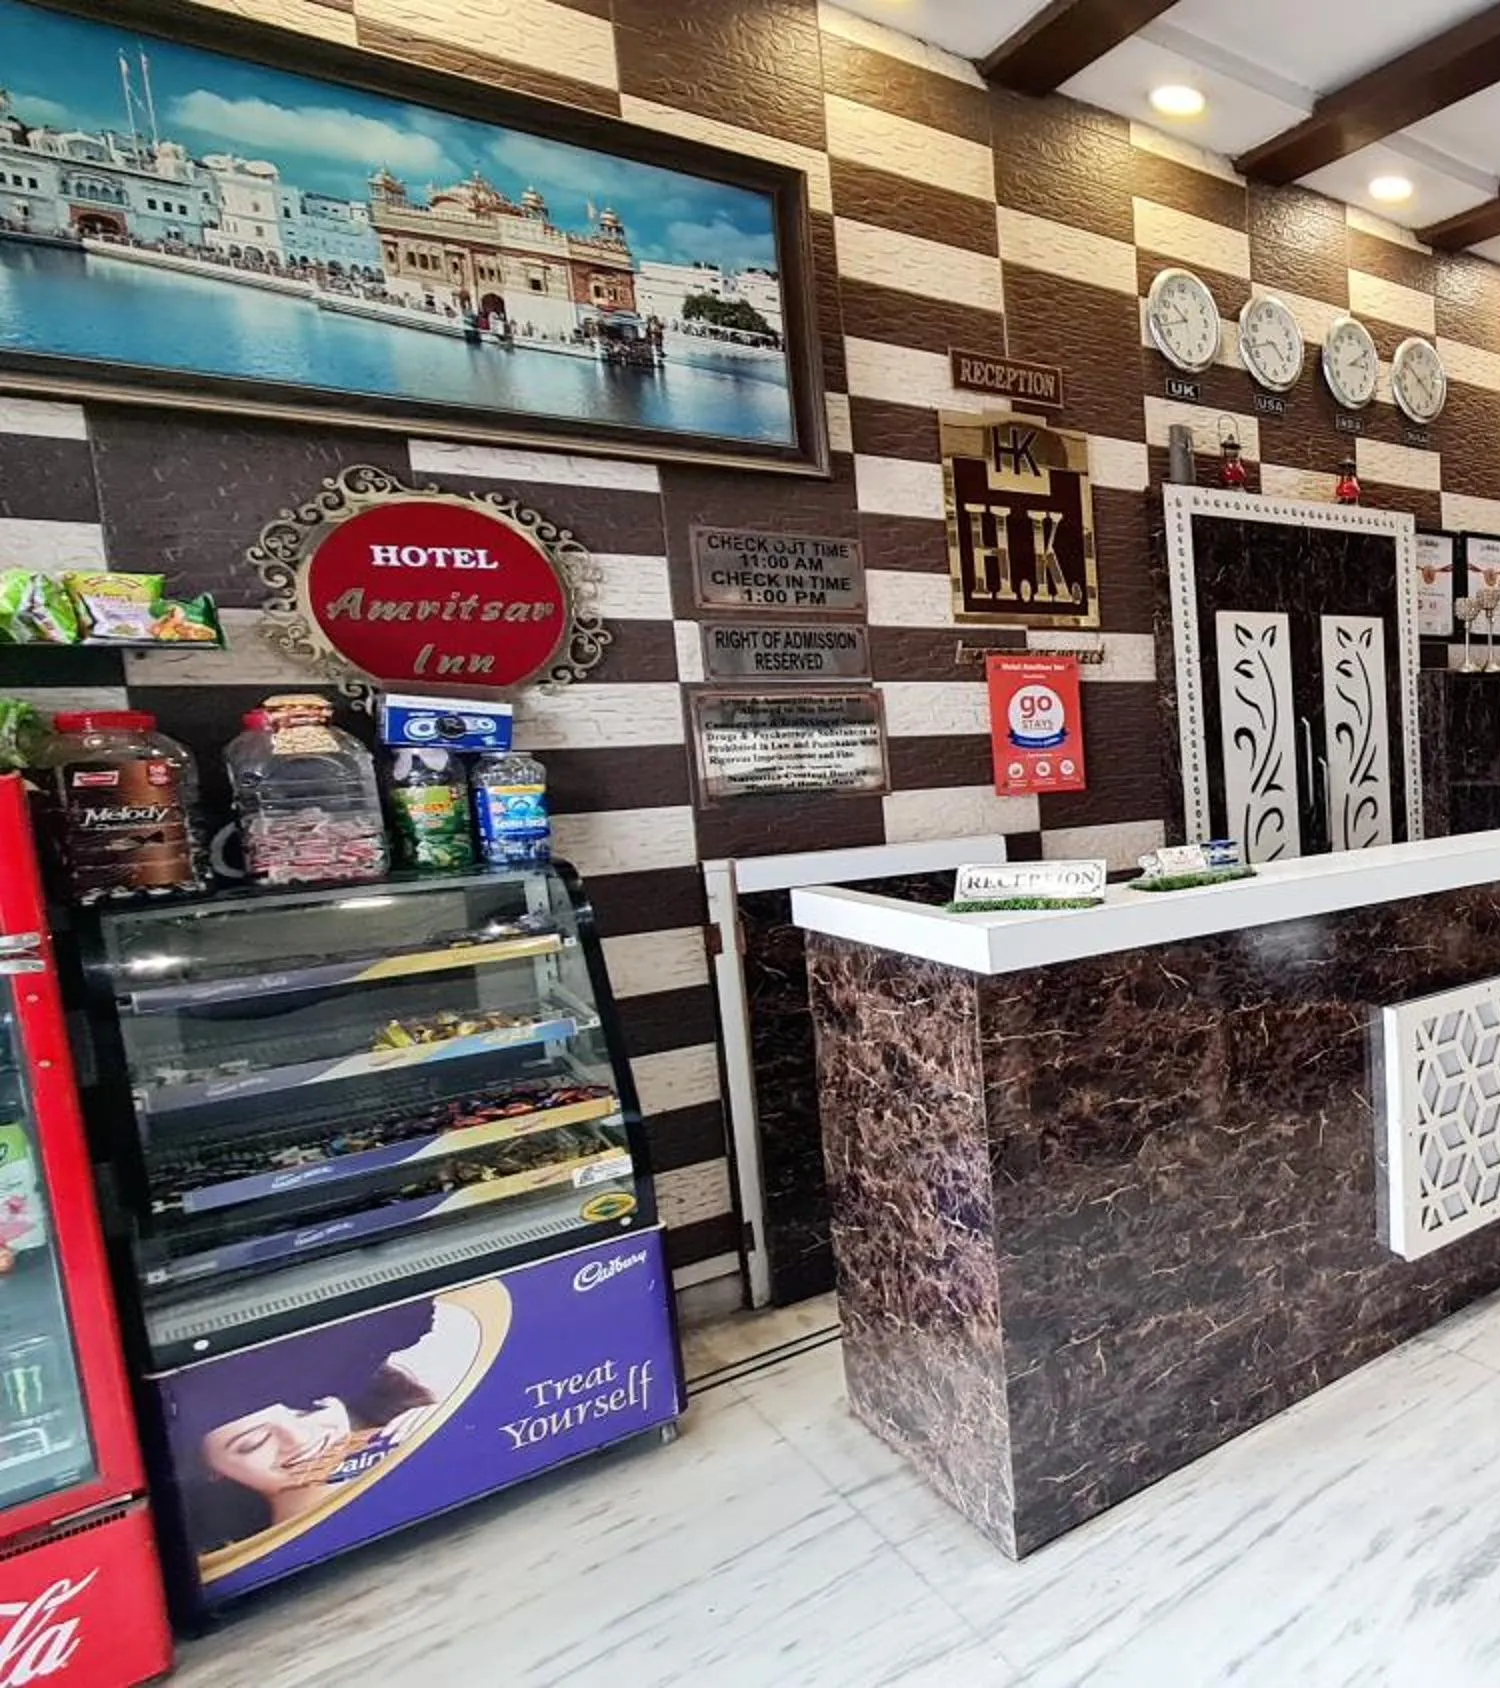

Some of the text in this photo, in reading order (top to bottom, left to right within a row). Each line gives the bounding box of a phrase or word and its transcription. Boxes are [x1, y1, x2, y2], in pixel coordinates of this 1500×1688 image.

[960, 358, 1055, 397] RECEPTION
[1171, 382, 1195, 397] UK
[992, 425, 1041, 477] HK
[369, 545, 499, 569] HOTEL
[707, 534, 769, 553] CHECK
[813, 542, 849, 558] TIME
[740, 554, 823, 572] 11:00 AM
[711, 571, 851, 591] CHECK IN TIME
[326, 587, 555, 622] Amritsar
[742, 589, 827, 604] 1:00 PM
[715, 630, 857, 649] RIGHT OF ADMISSION
[413, 643, 496, 676] Inn
[755, 653, 823, 670] RESERVED
[1020, 694, 1053, 719] go
[80, 805, 169, 827] Melody
[967, 871, 1096, 889] RECEPION
[573, 1249, 647, 1292] Cadbury
[525, 1359, 619, 1408] Treat
[499, 1359, 653, 1450] Yourself
